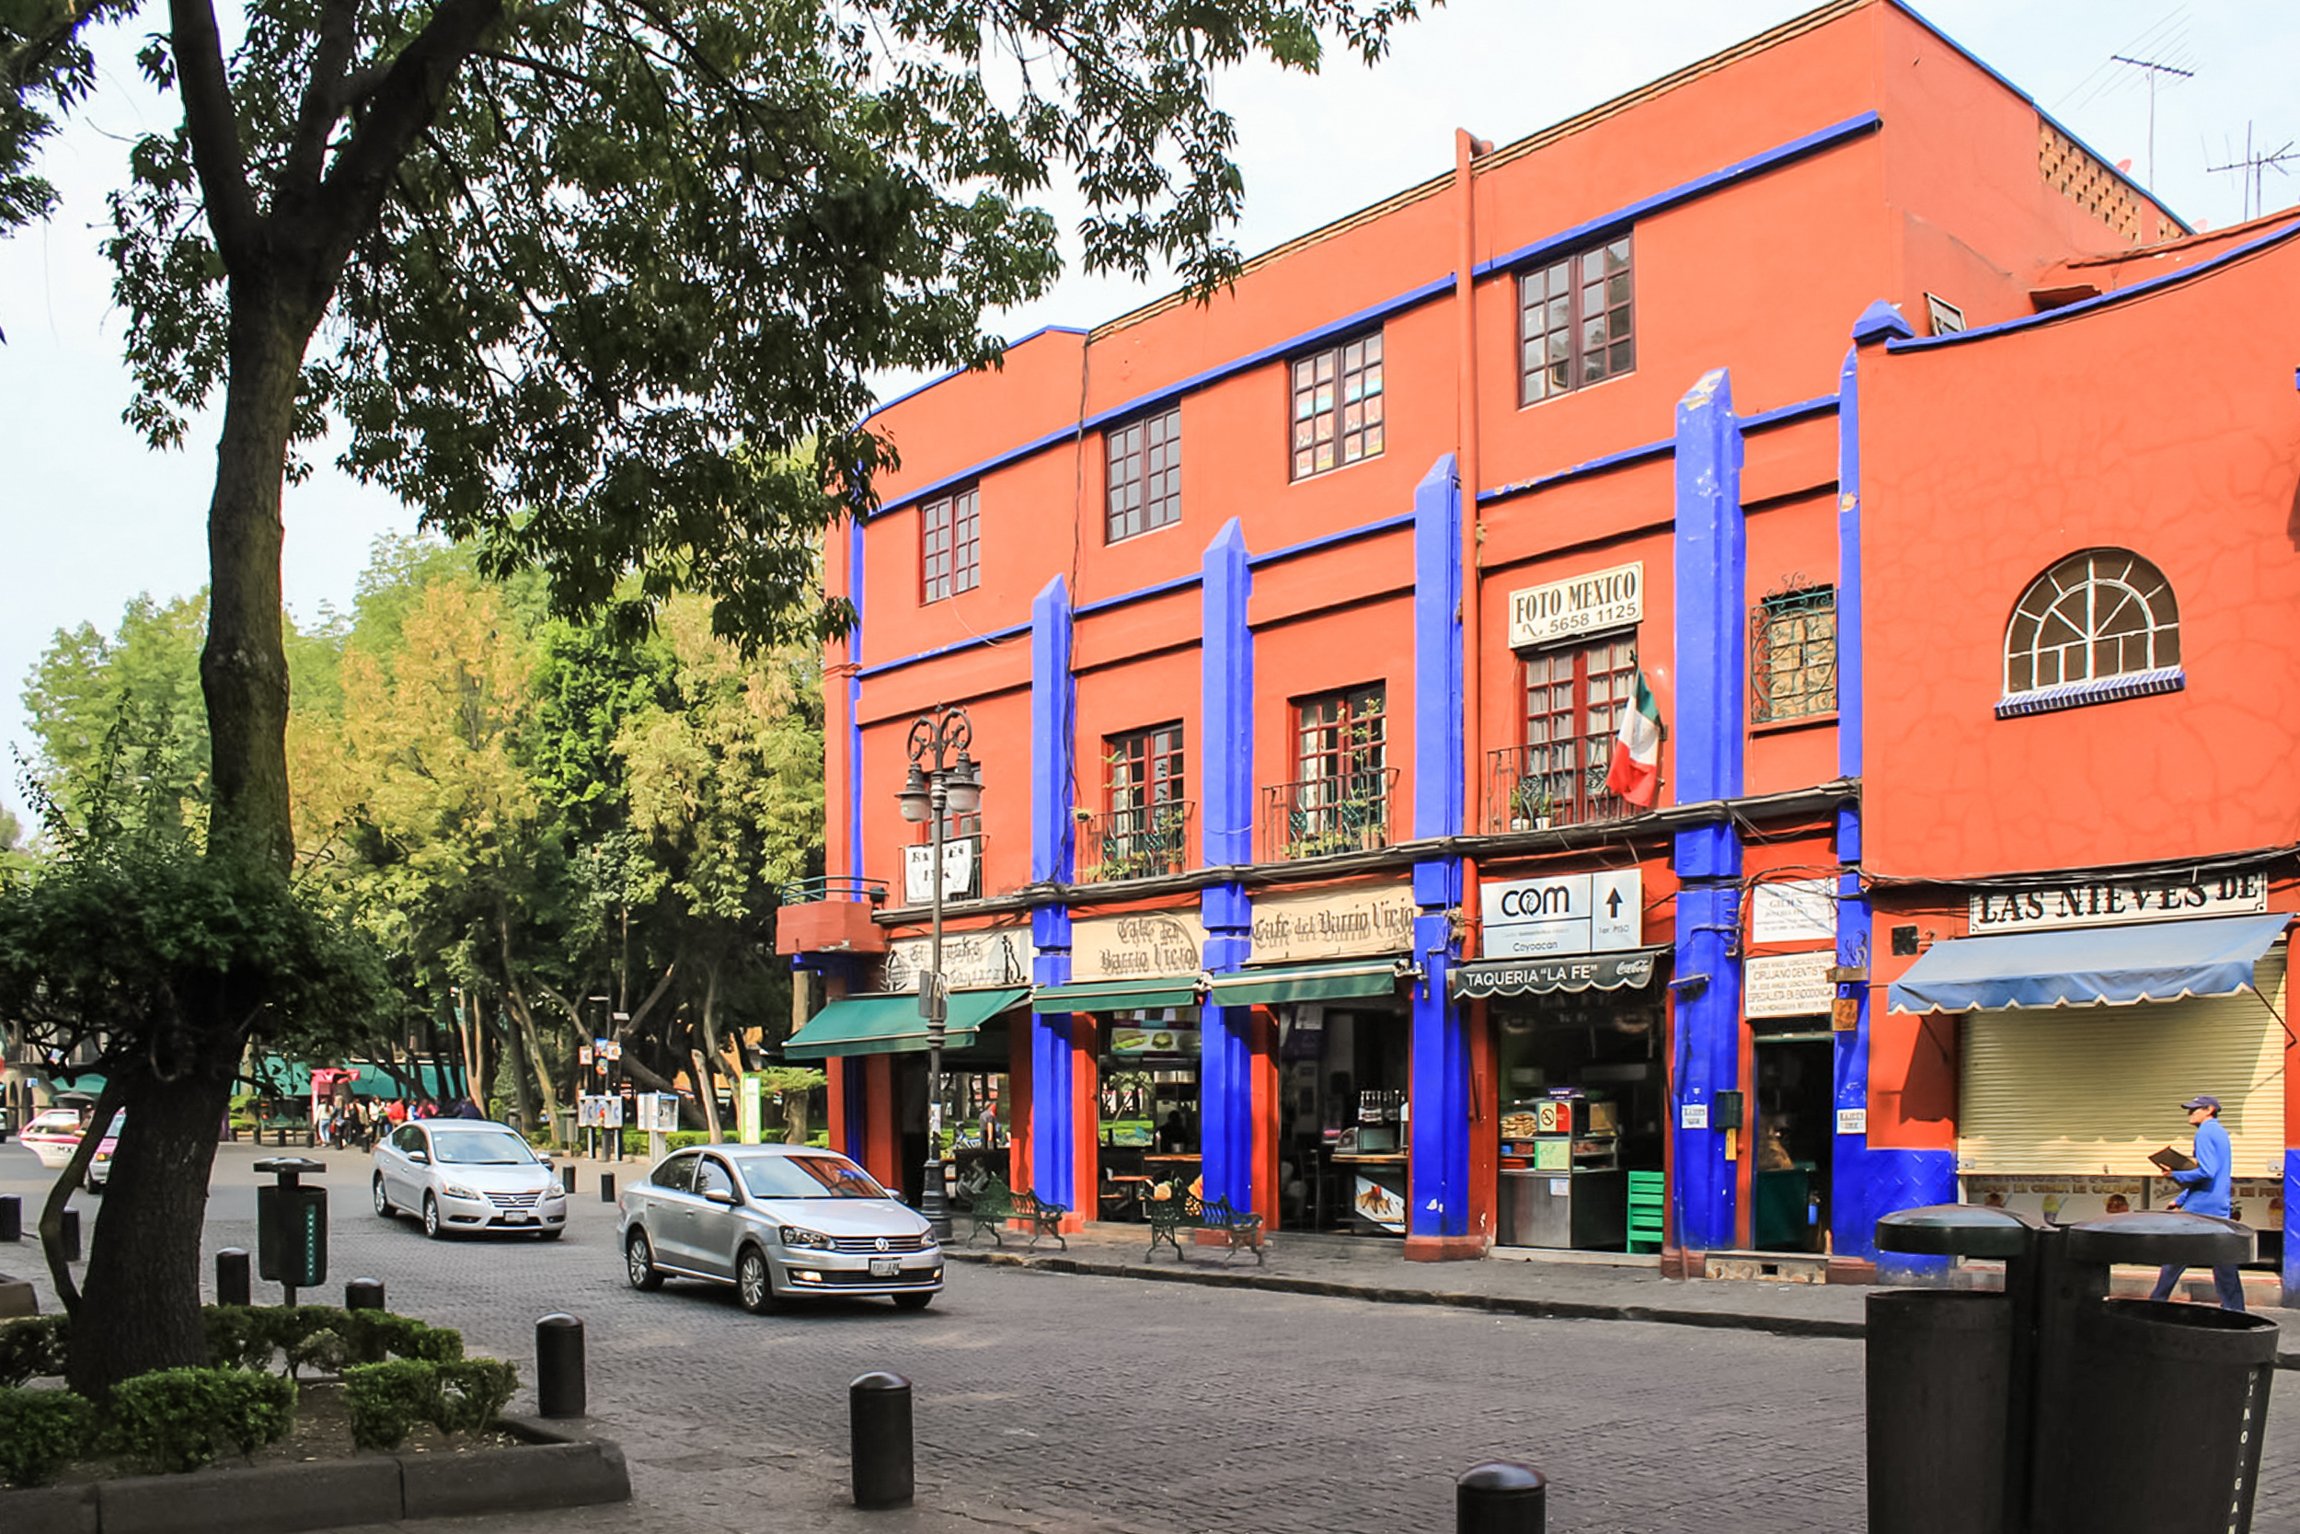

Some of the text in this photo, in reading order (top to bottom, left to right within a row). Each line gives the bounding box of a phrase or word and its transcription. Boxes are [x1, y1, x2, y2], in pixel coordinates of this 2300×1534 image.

[1515, 570, 1636, 625] FOTO MEXICO
[1549, 602, 1636, 634] 5658 1125
[1294, 914, 1314, 935] del
[1318, 903, 1368, 935] Barrio
[1372, 897, 1414, 934] Viejo
[1978, 874, 2258, 925] LAS NIEVES DE
[1100, 948, 1149, 972] Barrio
[1466, 969, 1539, 987] TAQUERIA
